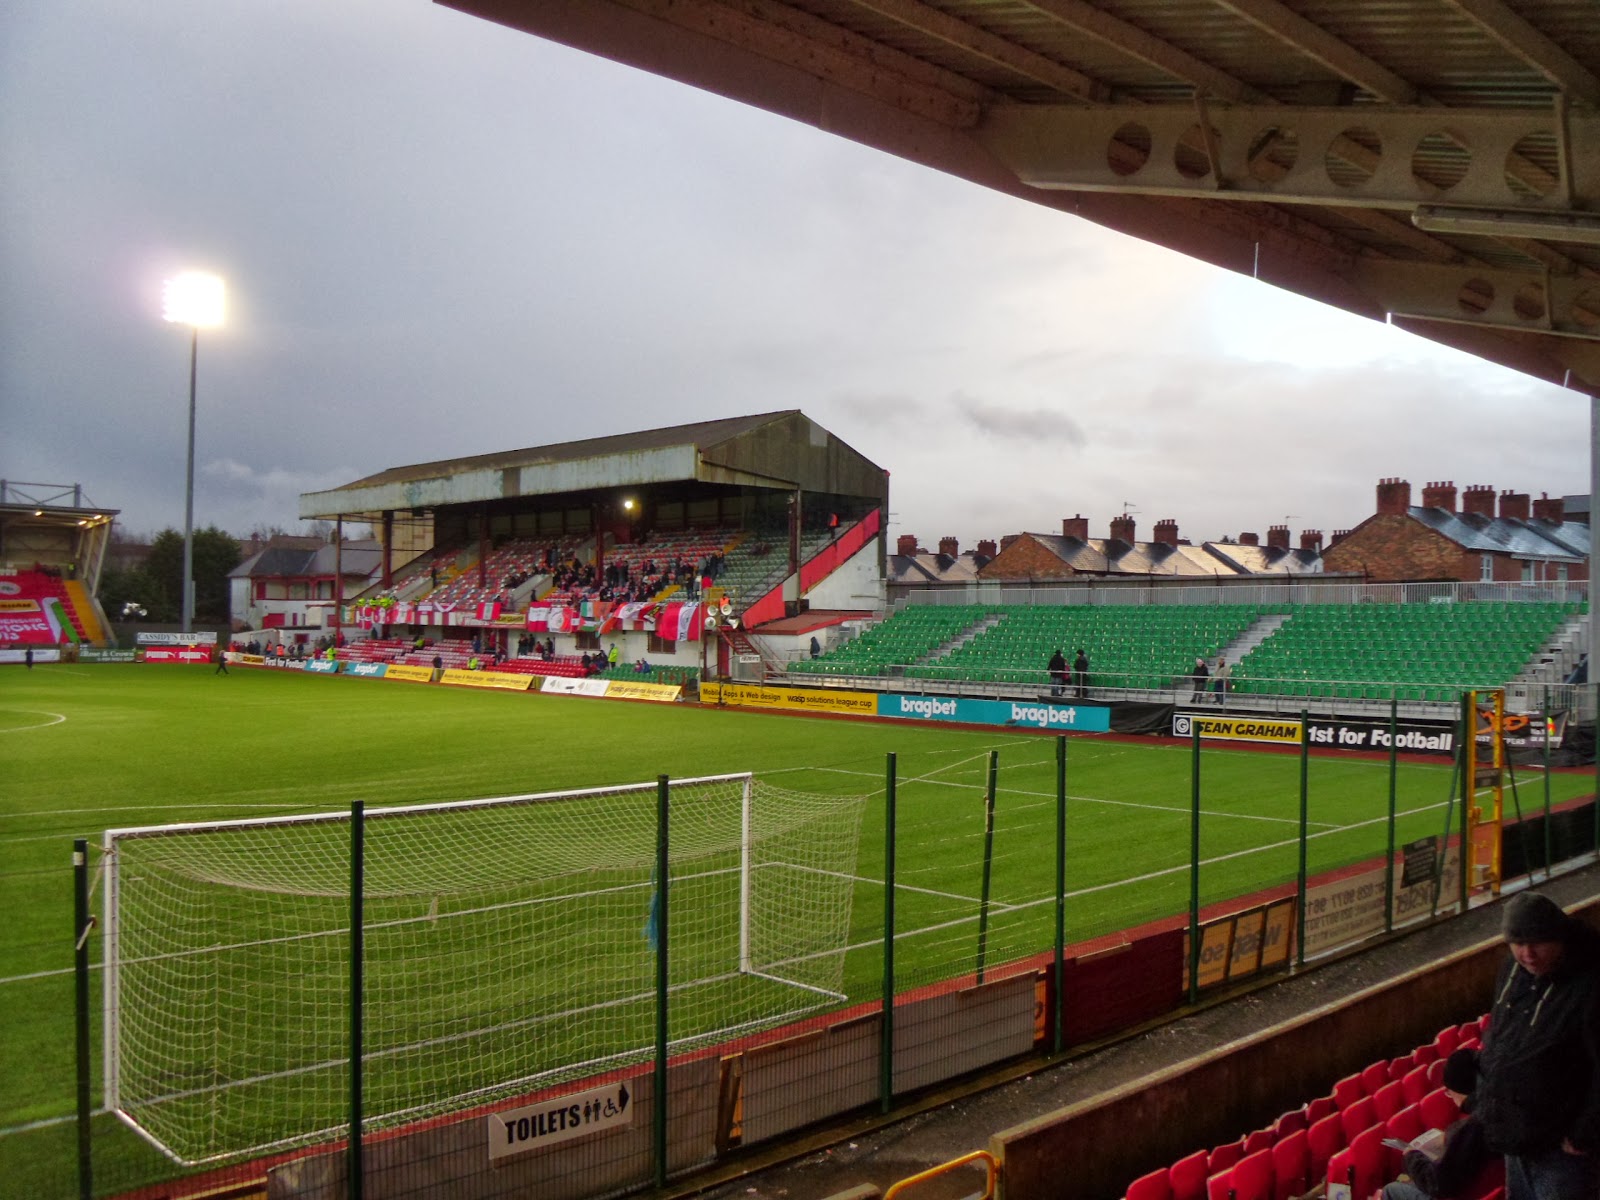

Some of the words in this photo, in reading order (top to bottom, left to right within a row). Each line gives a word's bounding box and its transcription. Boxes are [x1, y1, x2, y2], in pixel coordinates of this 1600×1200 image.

[138, 633, 179, 641] CASSIDY'S
[180, 633, 196, 641] BAR
[723, 690, 738, 698] Apps
[746, 691, 759, 699] Web
[761, 693, 781, 702] design
[806, 696, 835, 705] solutions
[836, 697, 858, 707] league
[859, 700, 873, 708] cup
[901, 696, 957, 718] bragbet
[1011, 703, 1076, 727] bragbet
[1235, 723, 1297, 739] GRAHAM
[1308, 726, 1334, 743] 1st
[1338, 727, 1367, 745] for
[1370, 729, 1453, 751] Football
[504, 1104, 581, 1144] TOILETS
